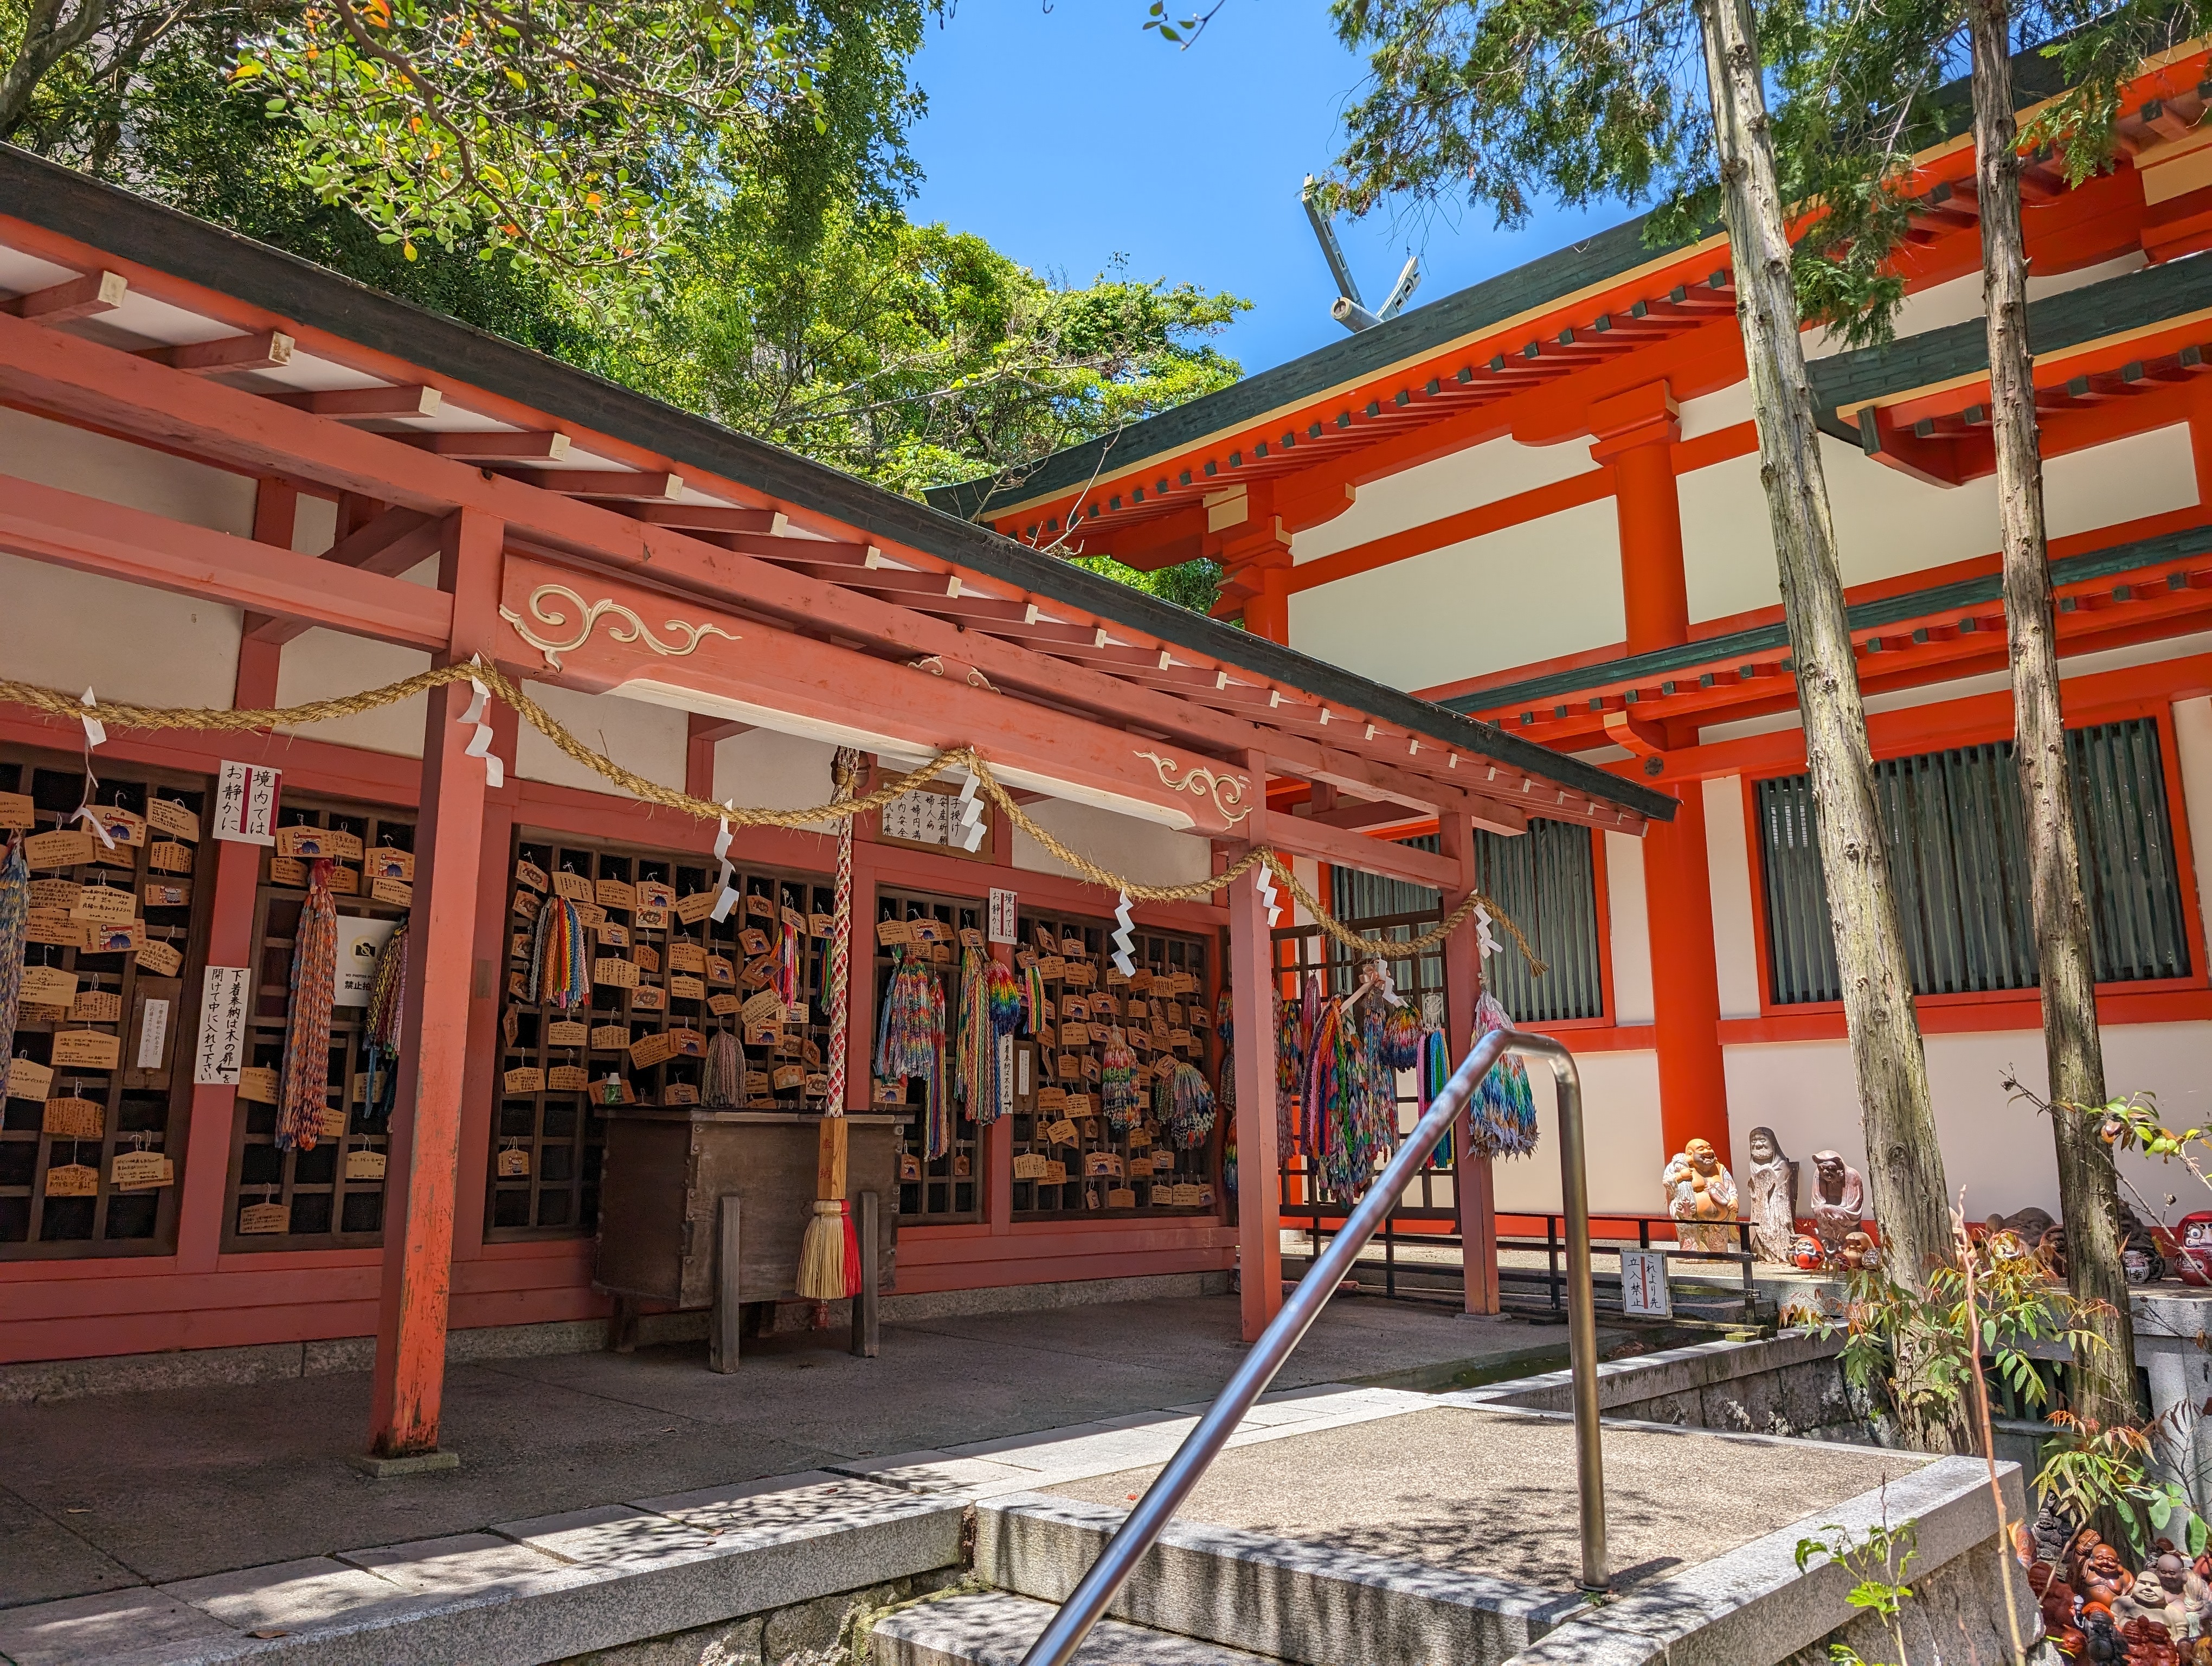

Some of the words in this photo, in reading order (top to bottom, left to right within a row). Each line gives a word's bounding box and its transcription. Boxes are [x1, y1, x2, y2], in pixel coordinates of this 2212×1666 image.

[222, 765, 243, 830] お静かに
[250, 770, 274, 835] 境内では
[883, 802, 894, 836] 気平癒
[910, 791, 922, 841] 夫婦円満
[925, 795, 936, 830] 婦人病
[937, 798, 948, 845] 安産祈願
[950, 798, 962, 837] 子授け
[991, 890, 1001, 935] お静かに
[1005, 893, 1014, 938] 境内では
[345, 981, 371, 991] 禁止拍
[201, 968, 224, 1081] 開けて中に入れて下さい
[219, 970, 244, 1084] 下着奉納は木の扉を
[1003, 1035, 1012, 1113] 下着奉納は木の扉を
[820, 1137, 833, 1180] 奉納
[1628, 1257, 1644, 1307] 立入禁止
[1646, 1254, 1661, 1309] これより先
